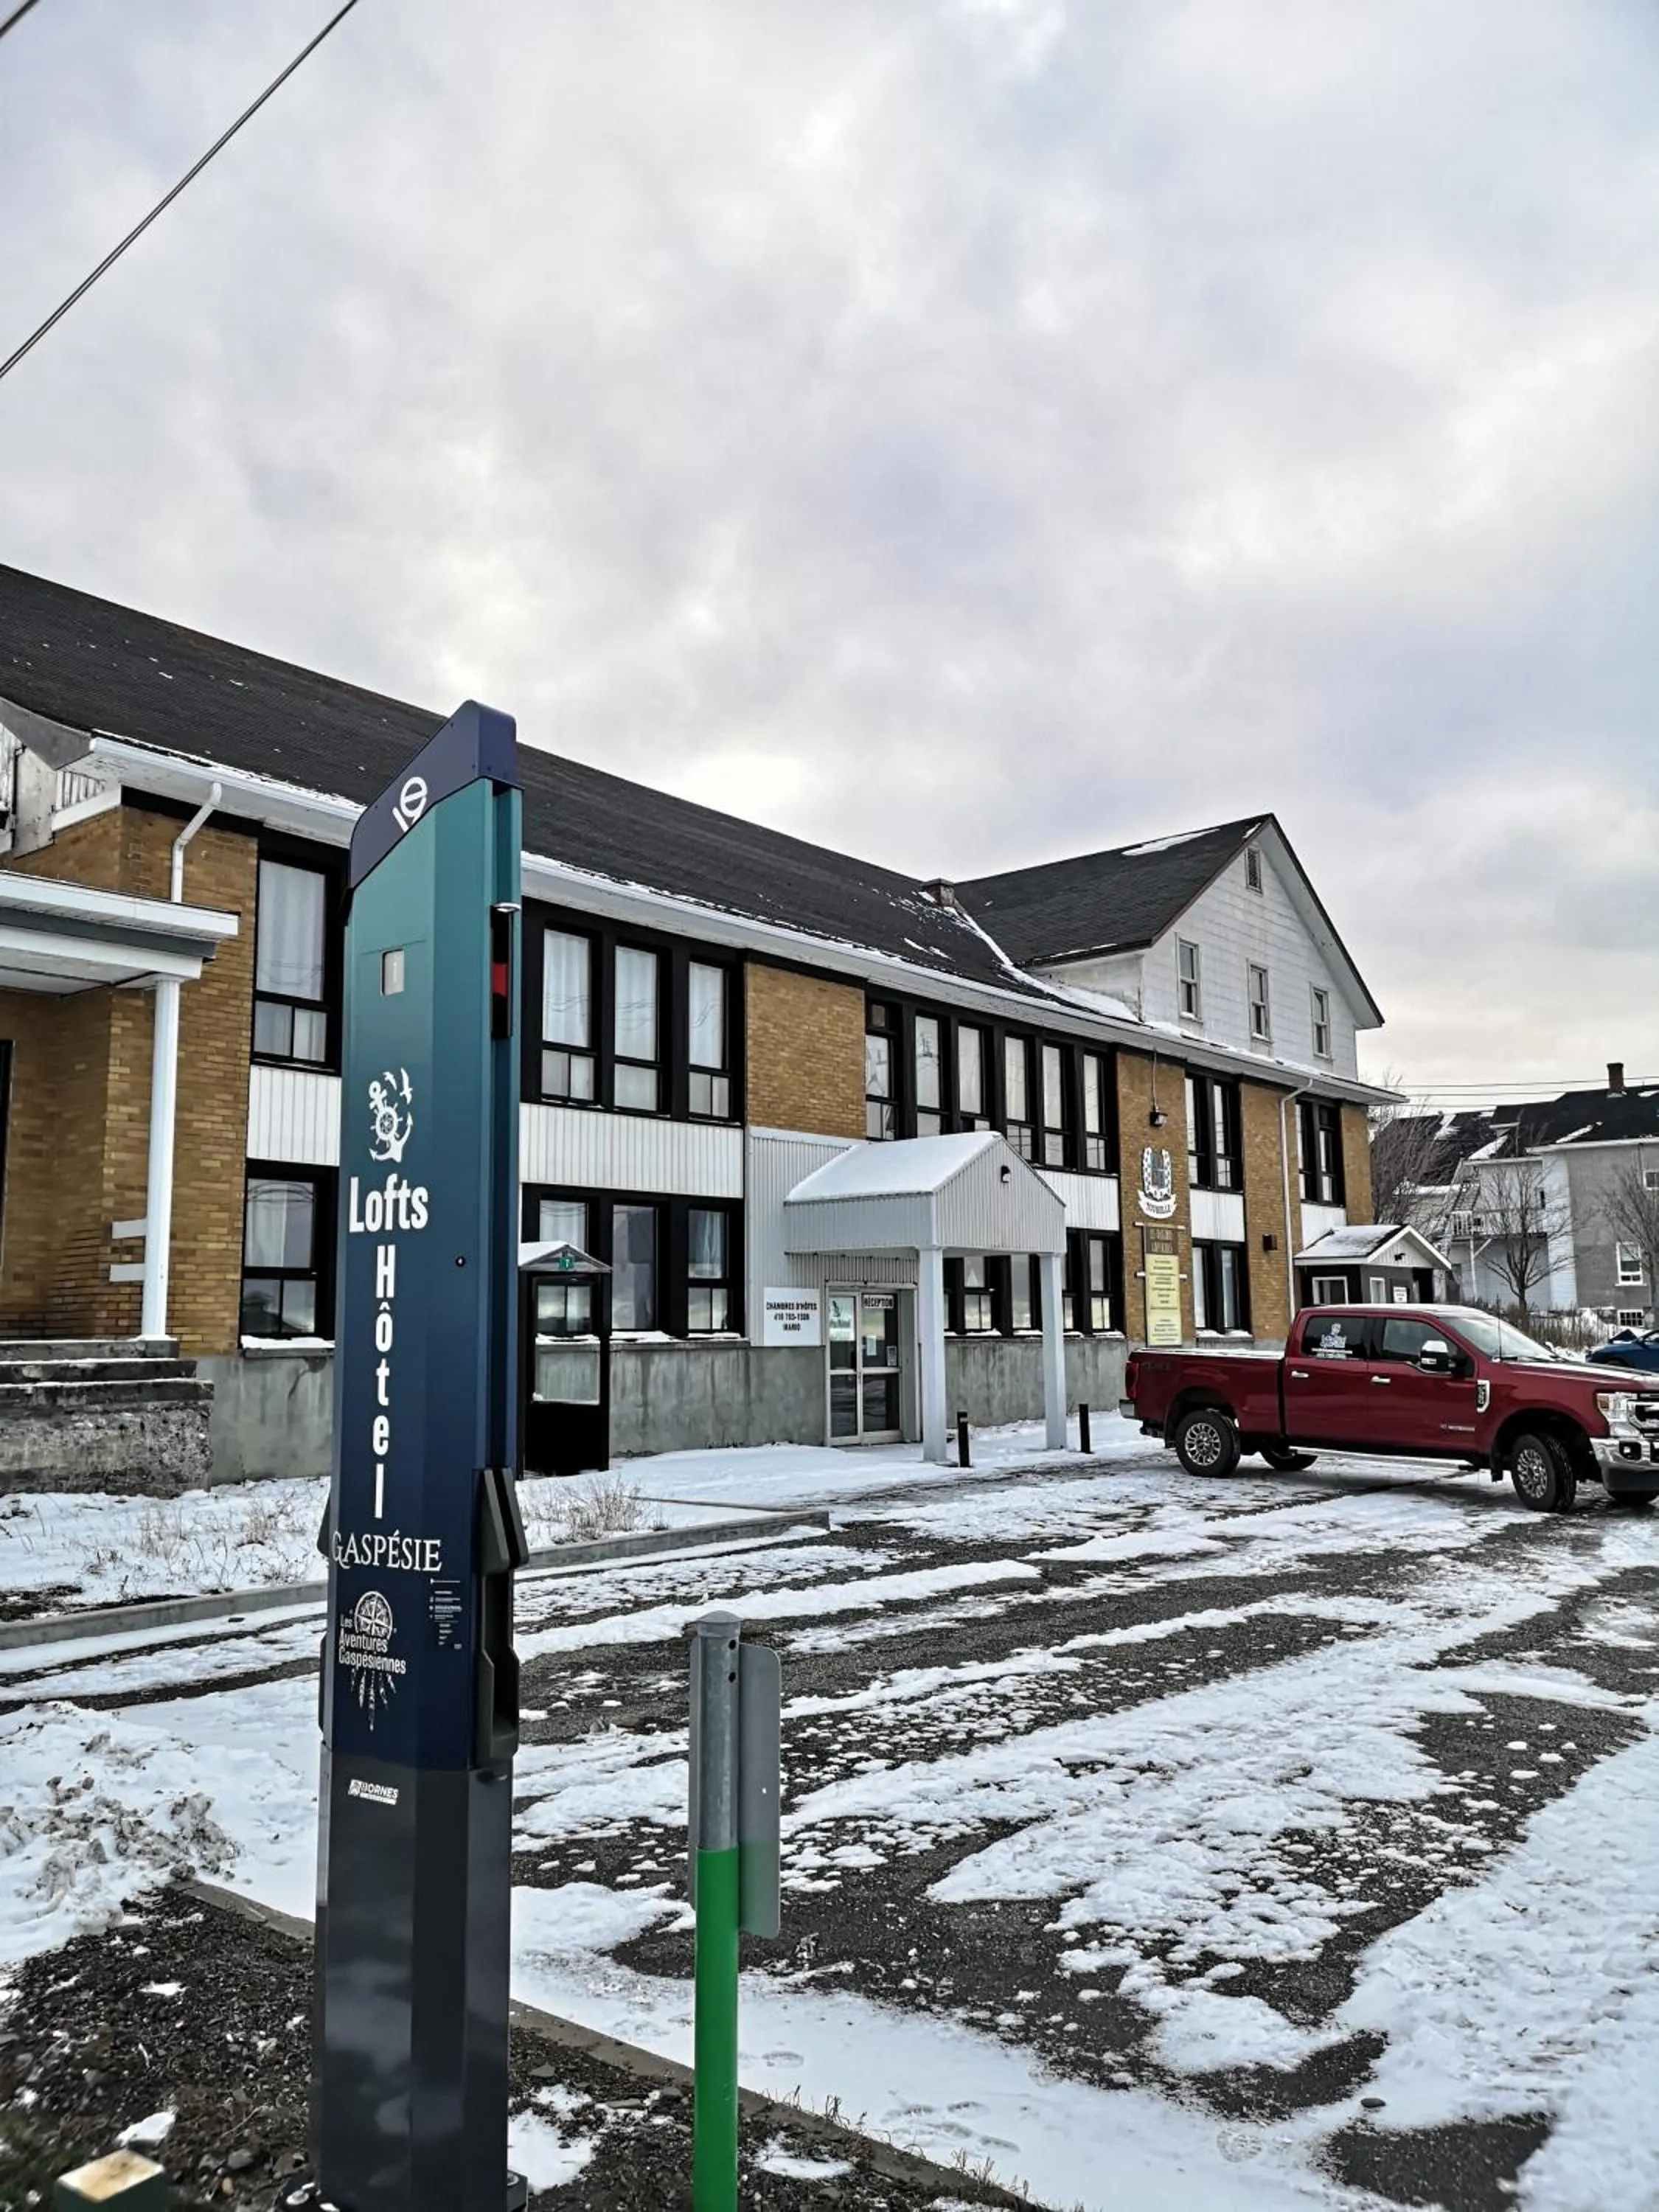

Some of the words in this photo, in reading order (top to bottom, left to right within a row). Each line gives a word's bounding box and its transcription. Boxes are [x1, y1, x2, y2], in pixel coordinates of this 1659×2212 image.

[349, 1173, 429, 1233] Lofts
[372, 1245, 396, 1518] Hôtel
[332, 1528, 443, 1572] GASPÉSIE
[340, 1614, 353, 1629] Les
[339, 1628, 388, 1652] Aventures
[339, 1645, 406, 1674] Gaspésiennes
